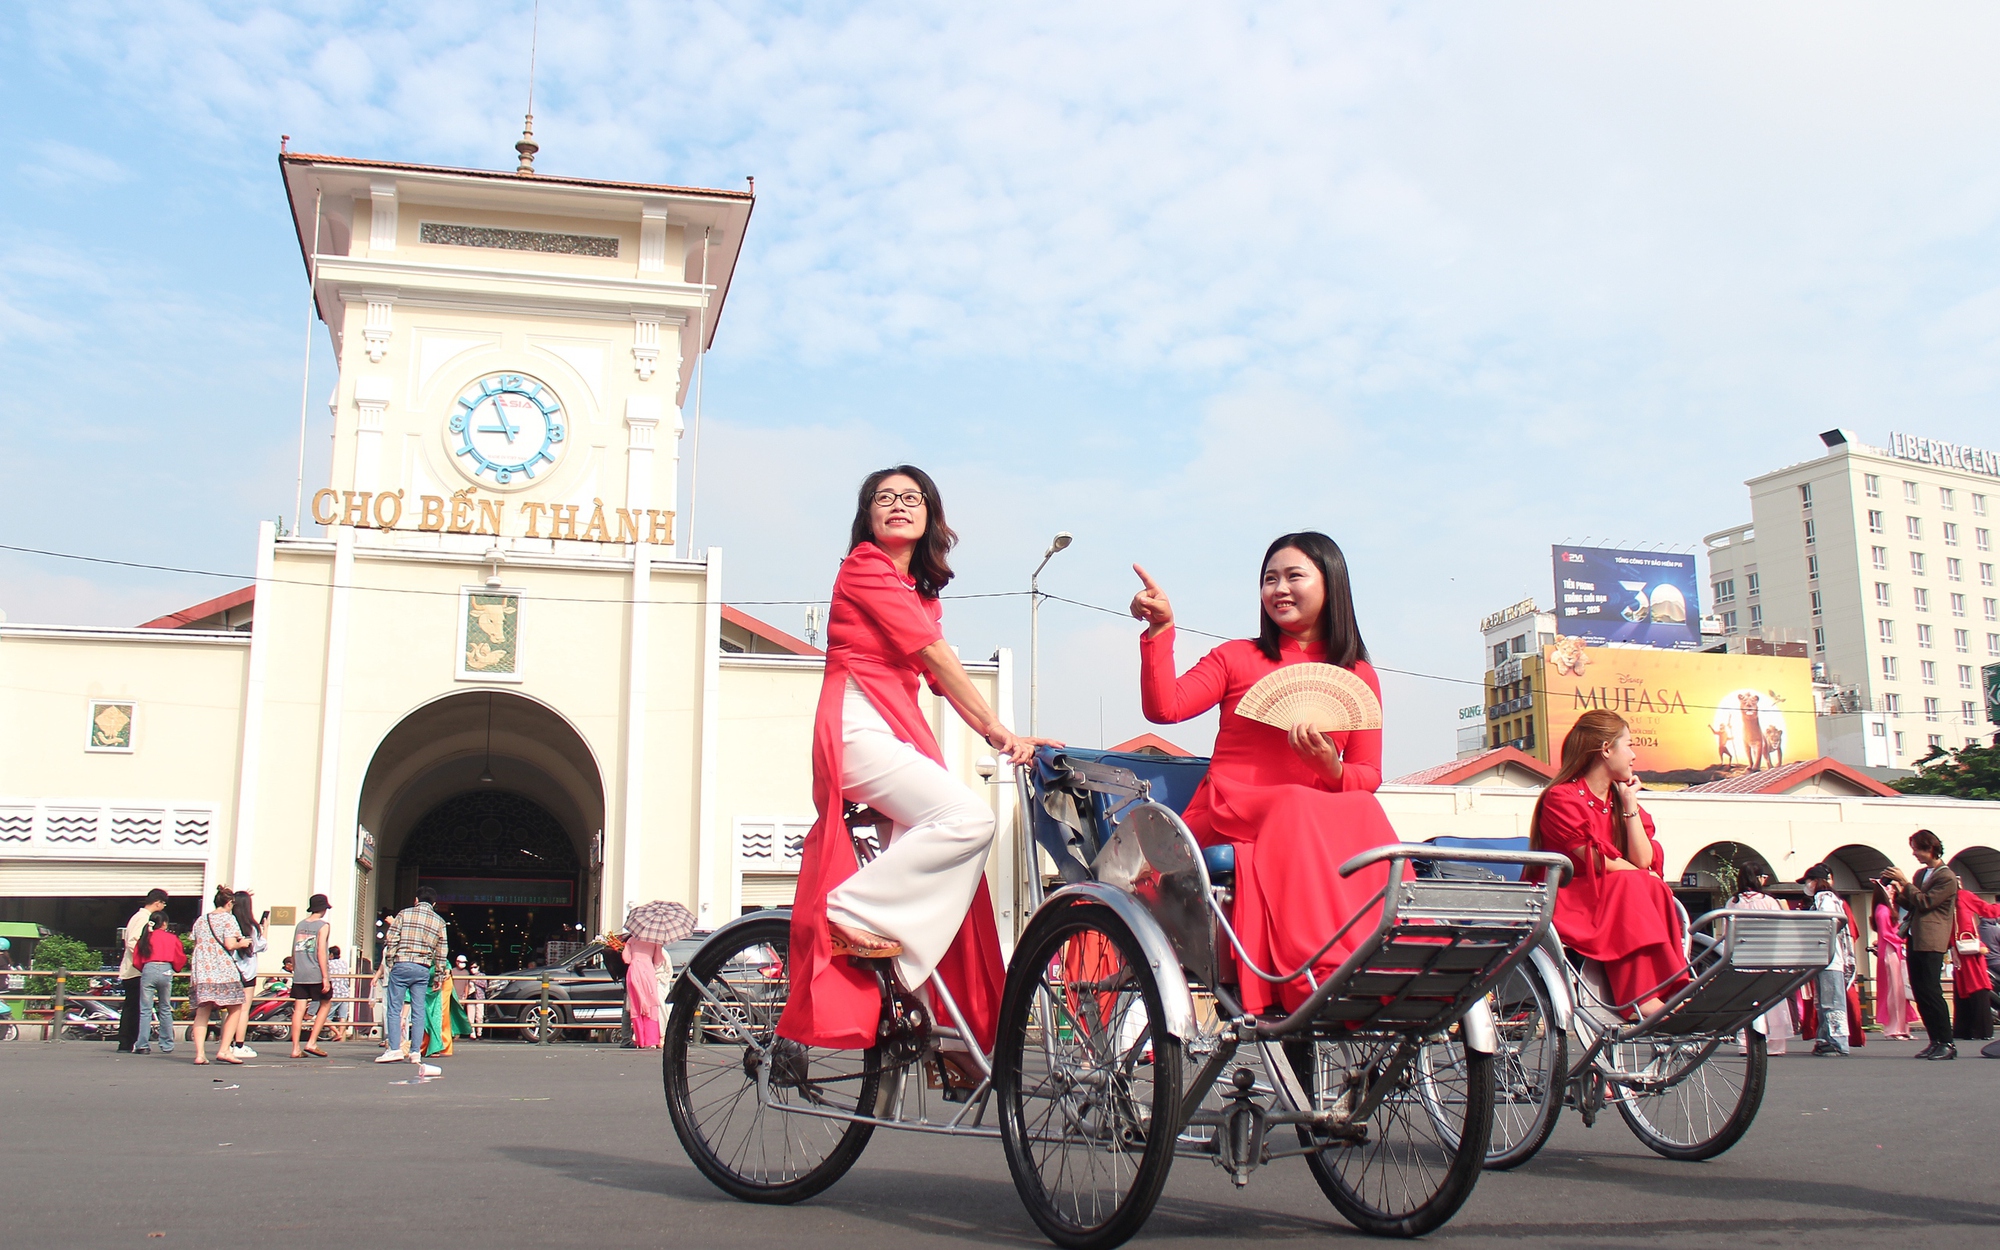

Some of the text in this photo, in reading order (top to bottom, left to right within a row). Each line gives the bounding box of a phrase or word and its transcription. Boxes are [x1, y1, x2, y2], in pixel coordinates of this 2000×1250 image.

[500, 374, 524, 391] 12
[449, 414, 465, 433] 9
[548, 423, 565, 443] 3
[1890, 431, 1960, 467] LIBERTY
[496, 467, 512, 484] 6
[311, 485, 676, 545] CHỢ BẾN THÀNH
[1576, 581, 1595, 591] PHONG
[1564, 591, 1607, 604] KHÔNG GIỚI HẠN
[1564, 606, 1578, 616] 1996
[1616, 673, 1644, 685] Disney
[1573, 686, 1689, 714] MUFASA
[1459, 705, 1481, 719] SONG
[1689, 874, 1697, 886] 16
